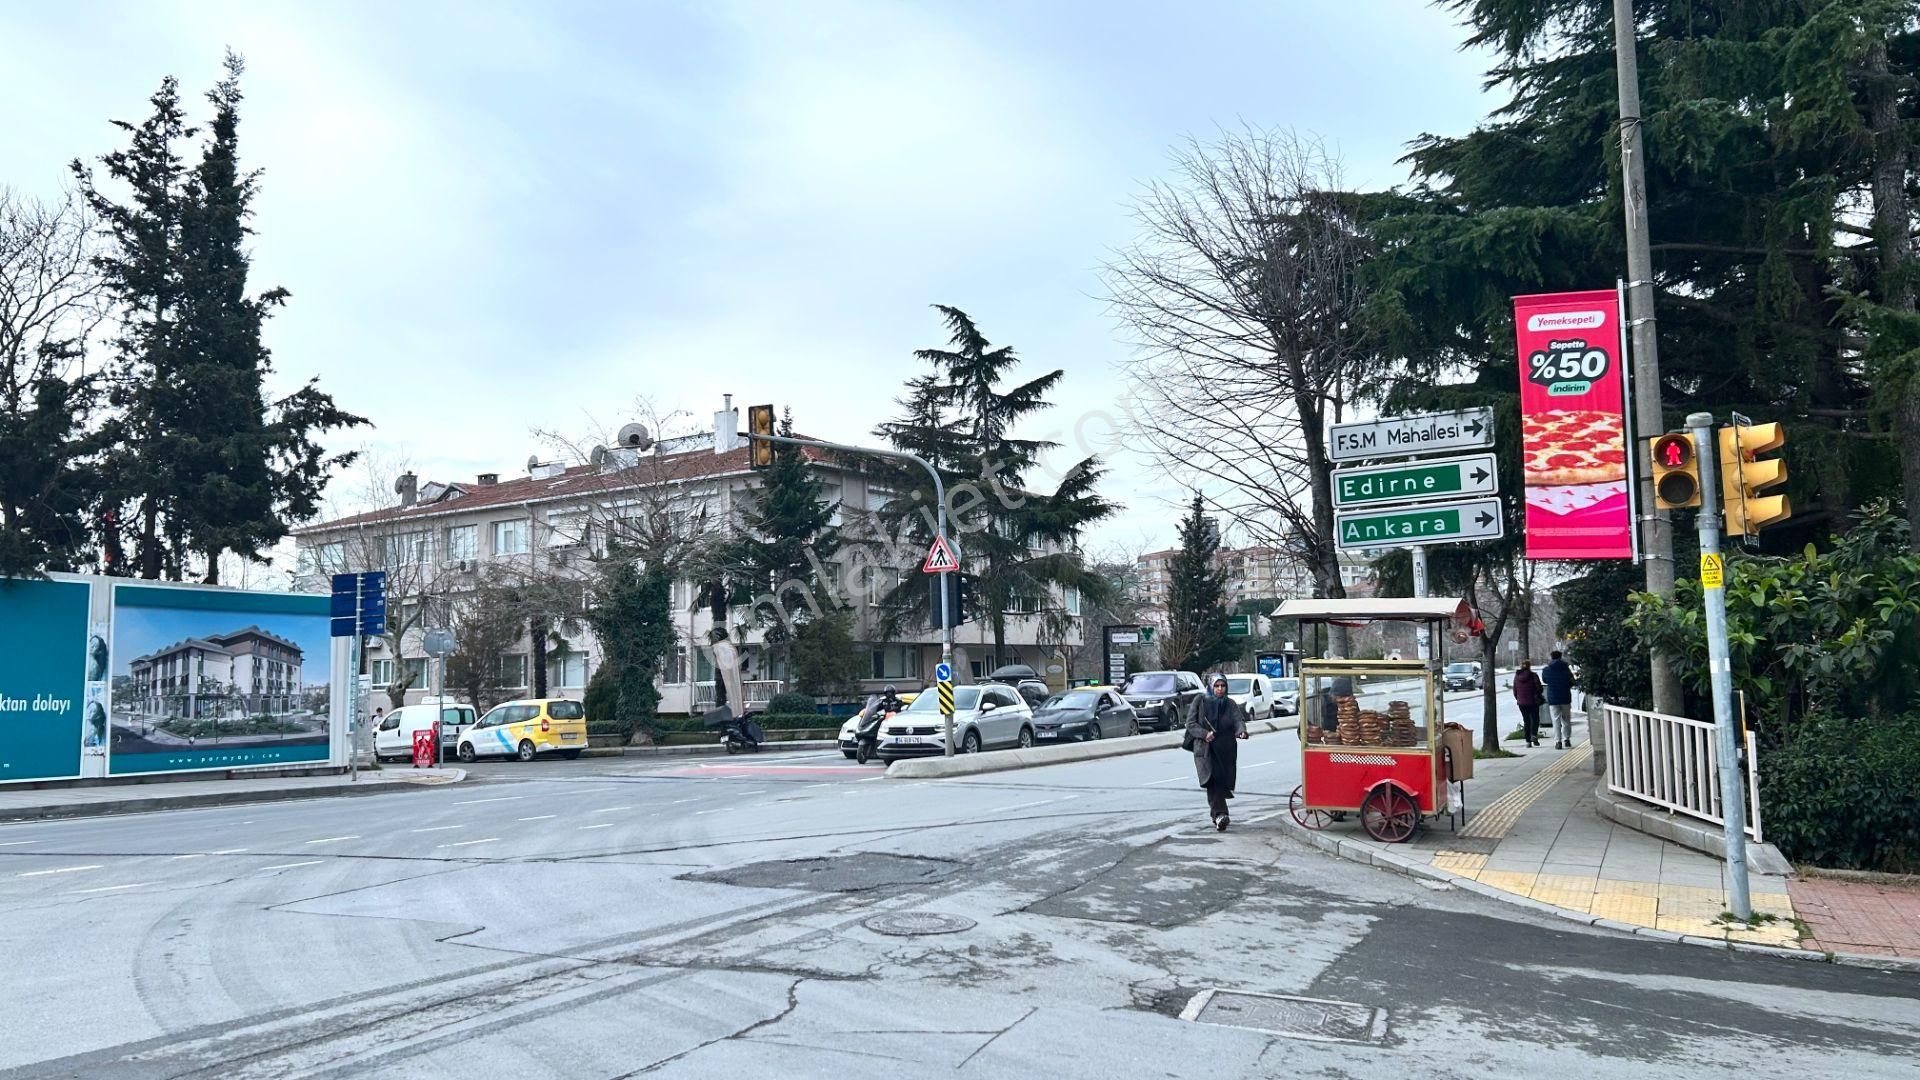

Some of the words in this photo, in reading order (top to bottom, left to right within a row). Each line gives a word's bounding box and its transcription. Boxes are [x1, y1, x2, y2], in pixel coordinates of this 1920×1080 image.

[1537, 314, 1595, 327] Yemeksepeti
[1532, 351, 1606, 379] %50
[1553, 384, 1586, 393] indirim
[1338, 431, 1377, 451] F.S.M
[1387, 422, 1459, 446] Mahallesi
[1343, 475, 1436, 497] Edirne
[1346, 517, 1445, 539] Ankara
[32, 693, 71, 715] dolayı
